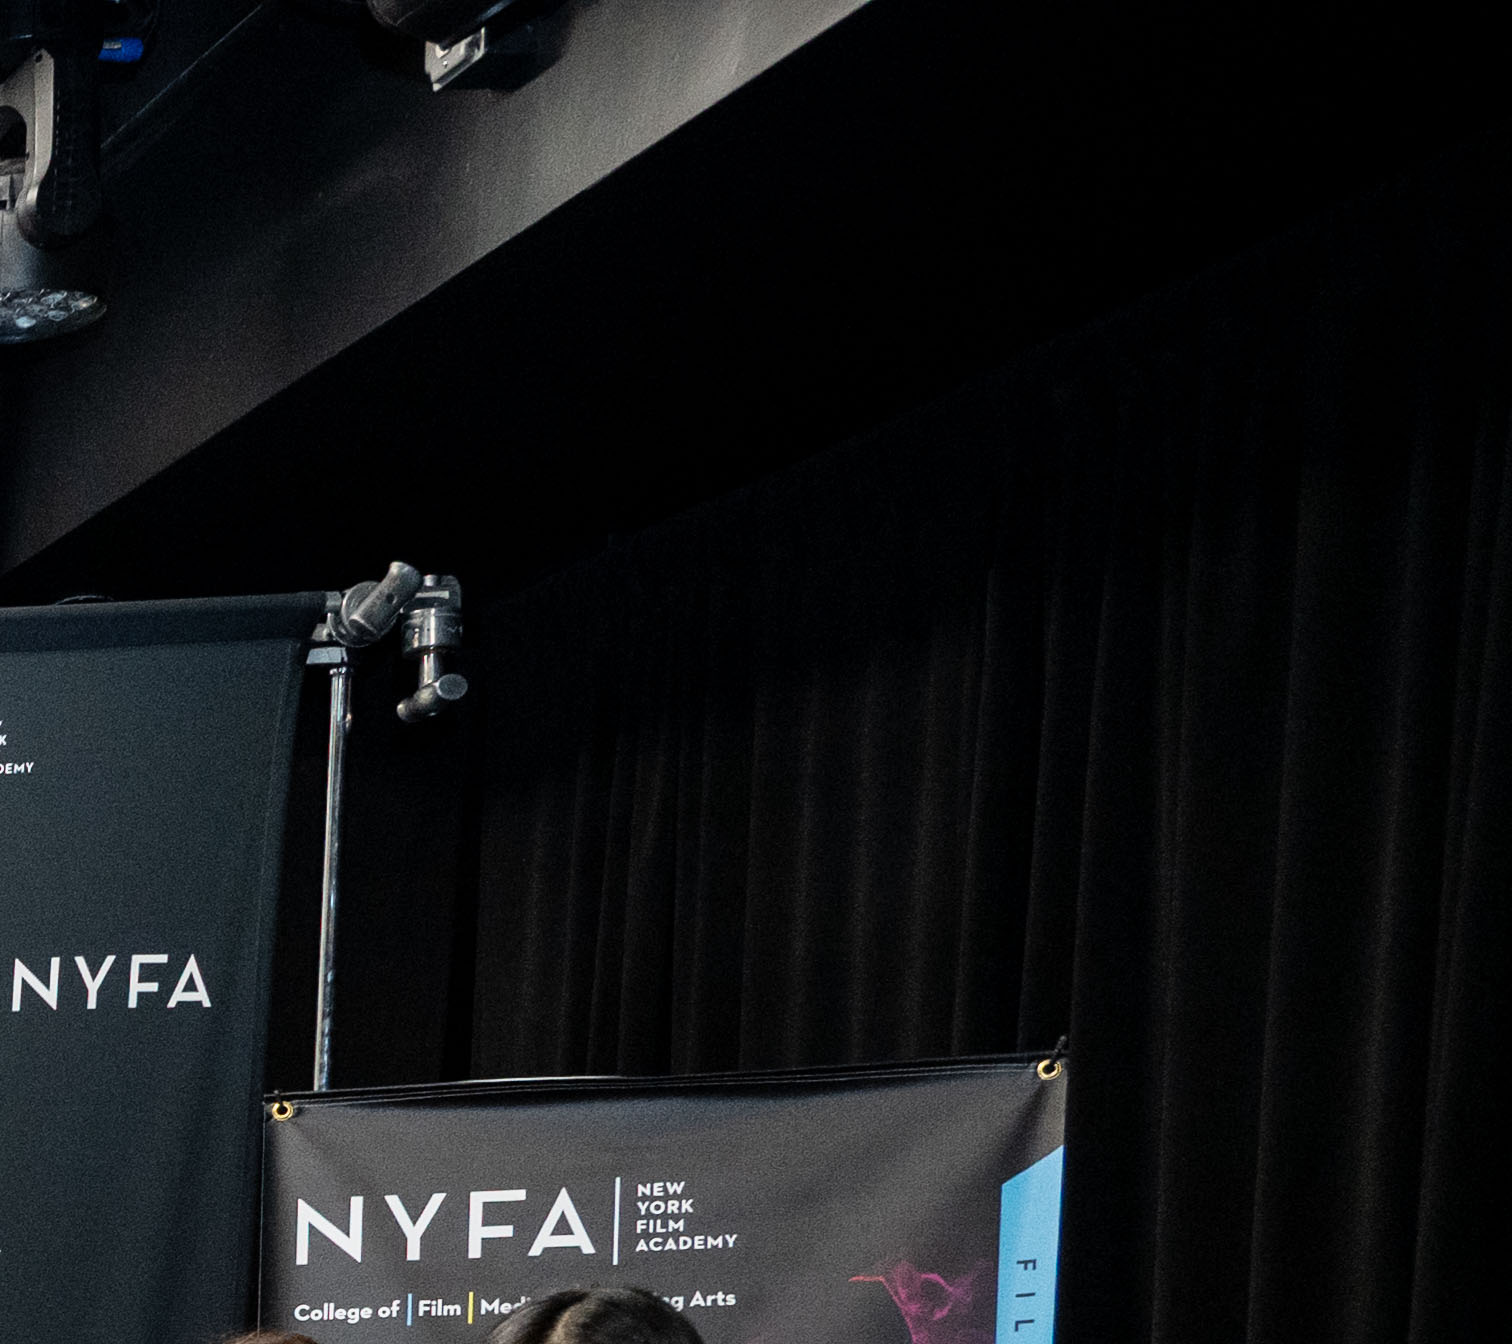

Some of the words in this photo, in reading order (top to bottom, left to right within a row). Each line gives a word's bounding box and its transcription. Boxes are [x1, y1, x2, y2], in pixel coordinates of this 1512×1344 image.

[11, 953, 212, 1012] NYFA
[637, 1181, 685, 1197] NEW
[637, 1198, 694, 1216] YORK
[295, 1187, 596, 1266] NYFA
[636, 1218, 685, 1234] FILM
[635, 1234, 738, 1252] ACADEMY
[294, 1302, 373, 1324] College
[377, 1299, 401, 1318] of
[418, 1298, 462, 1317] Film
[689, 1290, 737, 1307] Arts
